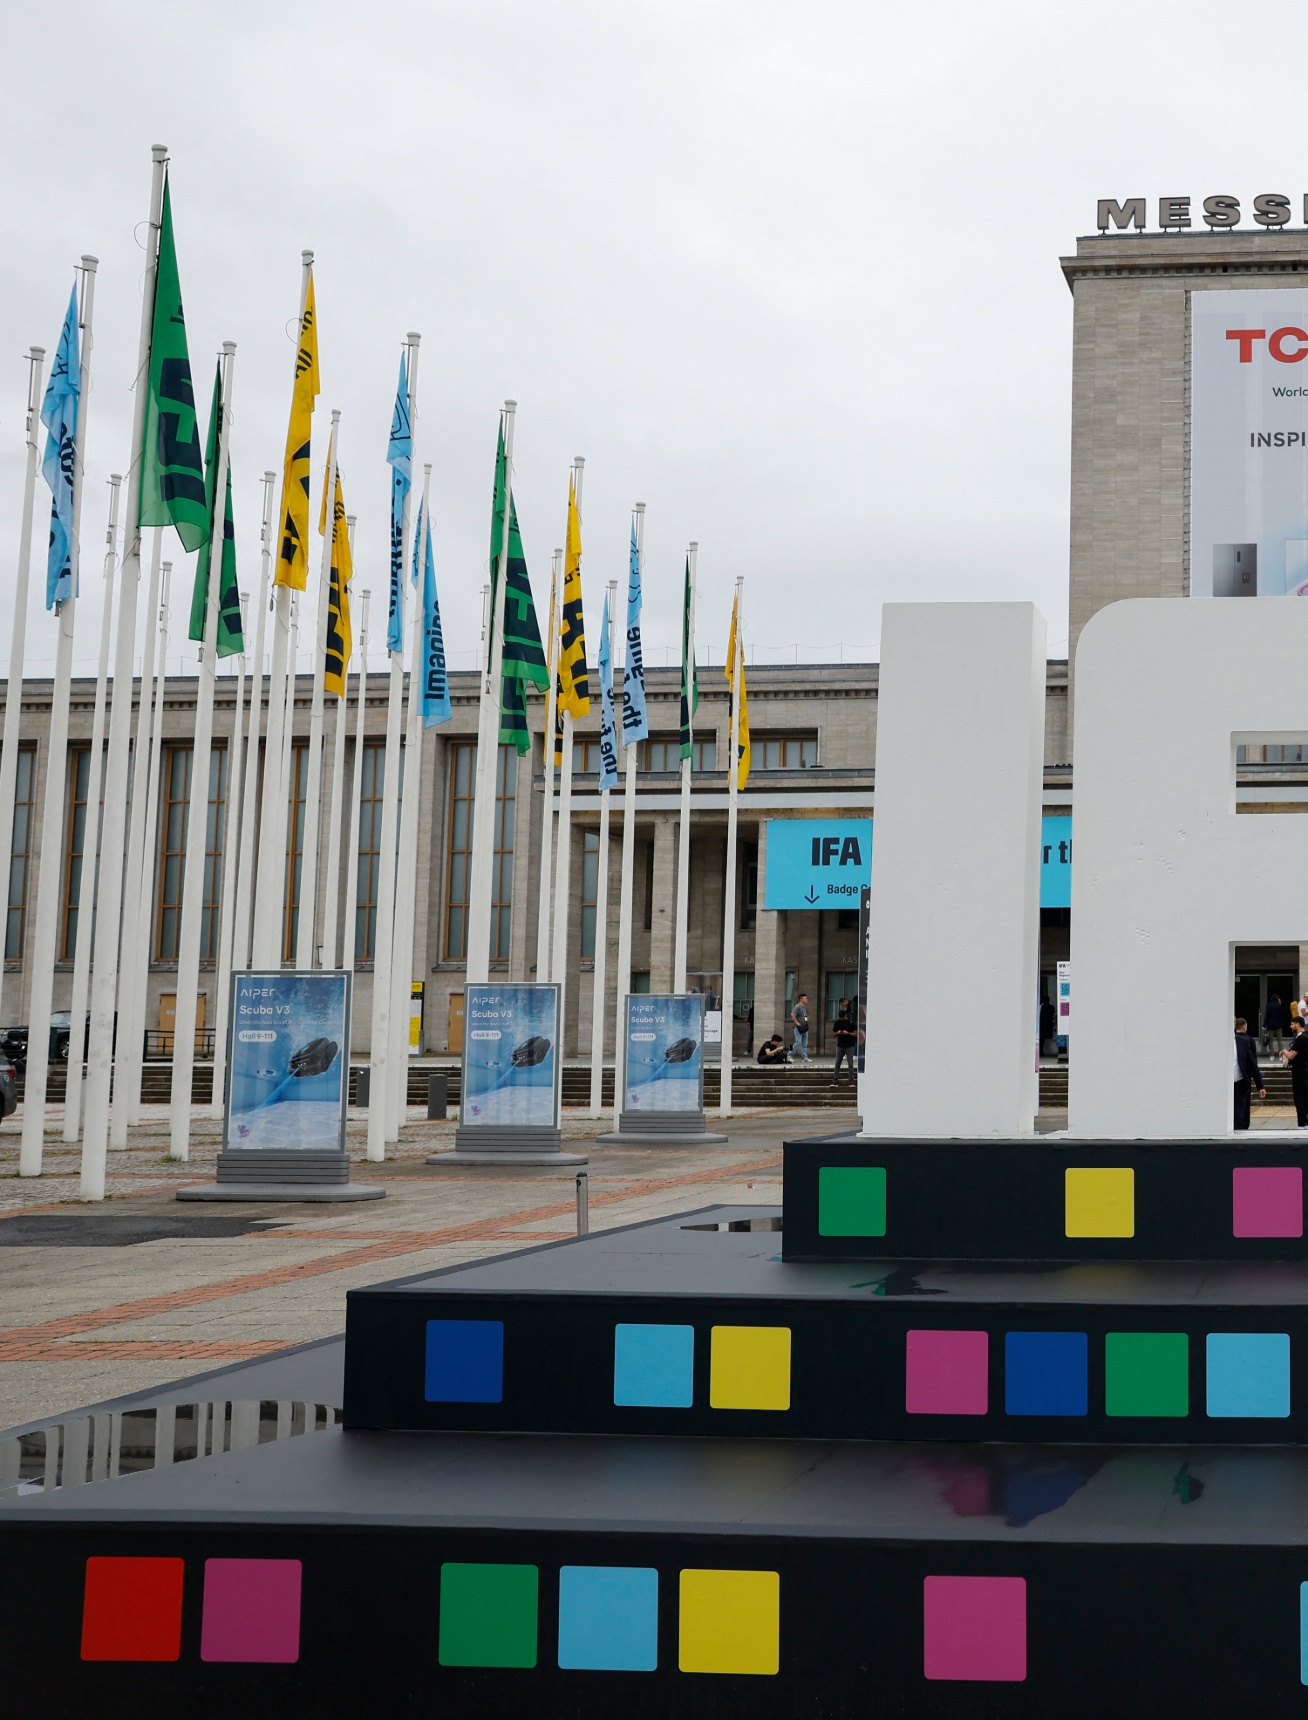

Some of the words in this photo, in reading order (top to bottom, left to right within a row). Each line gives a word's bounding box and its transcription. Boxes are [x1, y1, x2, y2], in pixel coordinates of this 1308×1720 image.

[811, 837, 862, 866] IFA
[827, 884, 859, 896] Badge
[239, 1005, 273, 1015] Scuba
[276, 1005, 291, 1014] V3
[471, 1010, 499, 1018] Scuba
